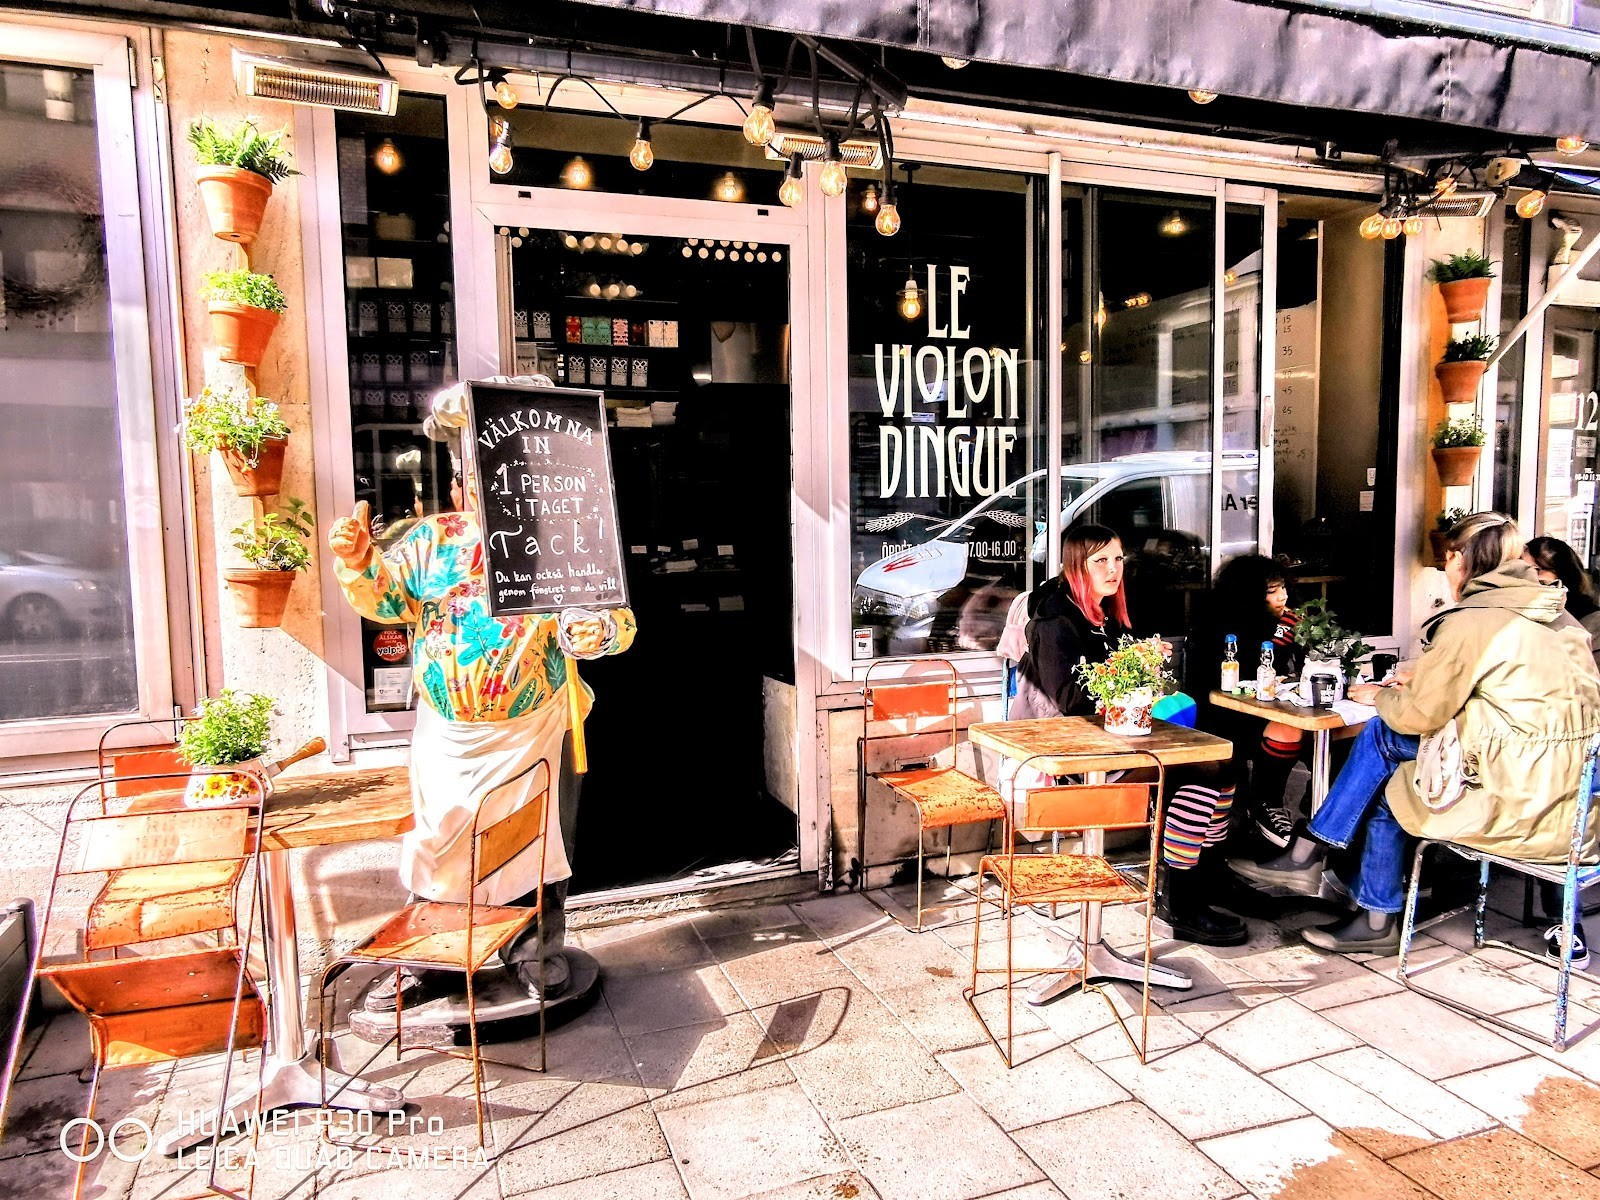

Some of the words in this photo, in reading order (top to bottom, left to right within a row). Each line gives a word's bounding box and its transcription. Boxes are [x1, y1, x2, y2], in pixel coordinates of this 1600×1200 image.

[927, 264, 970, 339] LE
[1282, 345, 1293, 355] 35
[875, 343, 1019, 419] VIOLON
[1573, 391, 1598, 430] 12
[478, 408, 593, 449] VÄLKOMNA
[521, 436, 551, 455] IN
[879, 425, 1017, 498] DINGUE
[496, 463, 512, 494] 1
[520, 474, 587, 494] PERSON
[524, 497, 584, 517] TAGET
[495, 570, 510, 583] Du
[513, 570, 532, 582] kan
[536, 567, 564, 580] också
[567, 561, 604, 578] handla
[498, 588, 526, 603] genom
[529, 582, 566, 600] fönstret
[598, 576, 616, 592] vill
[377, 645, 398, 656] yelp
